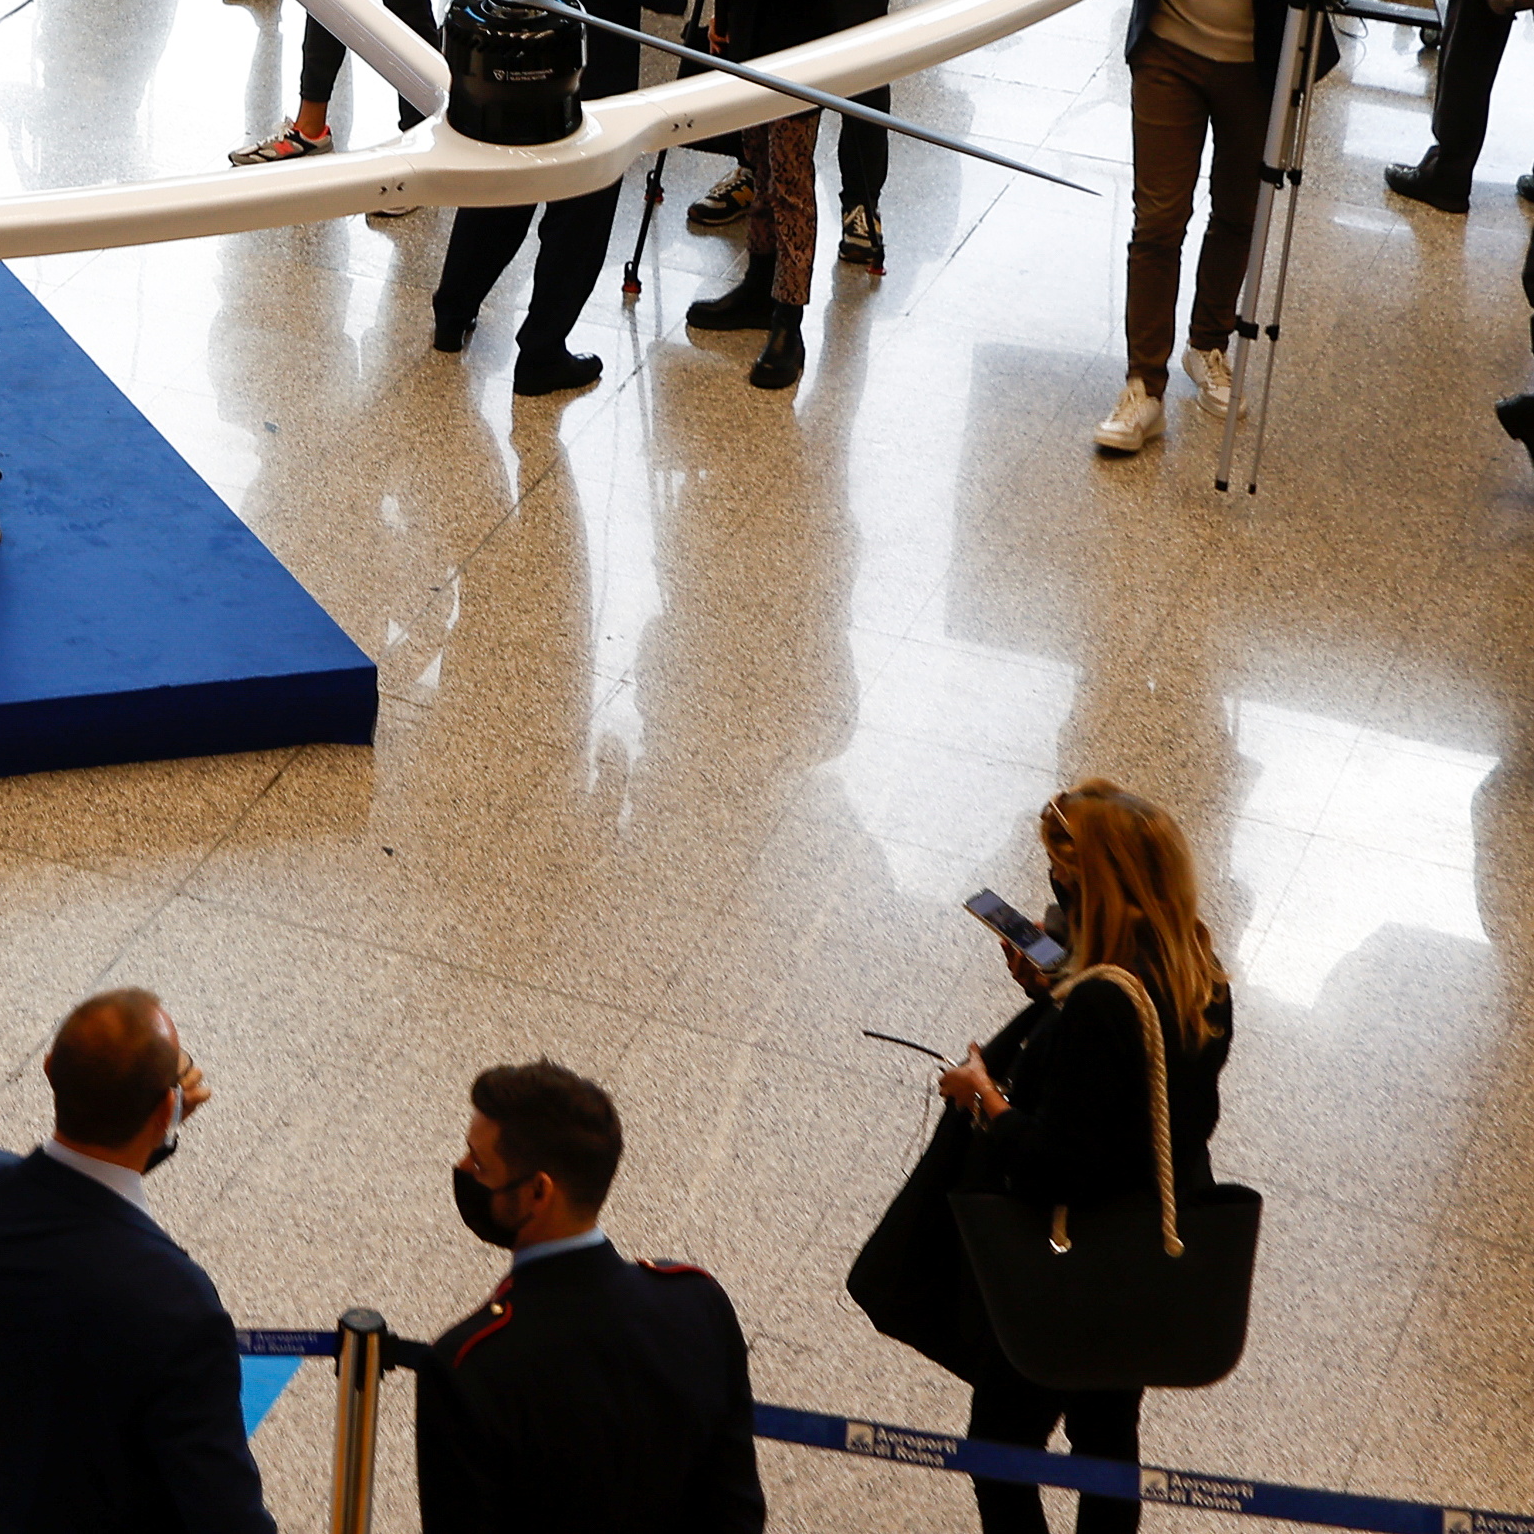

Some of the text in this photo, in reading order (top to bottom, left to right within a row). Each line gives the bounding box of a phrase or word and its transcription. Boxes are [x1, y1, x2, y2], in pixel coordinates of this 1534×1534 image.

[875, 1426, 958, 1455] Aeroporti
[875, 1443, 945, 1467] di Roma
[1170, 1472, 1254, 1500] Aeroporti
[1169, 1488, 1242, 1511] di Roma
